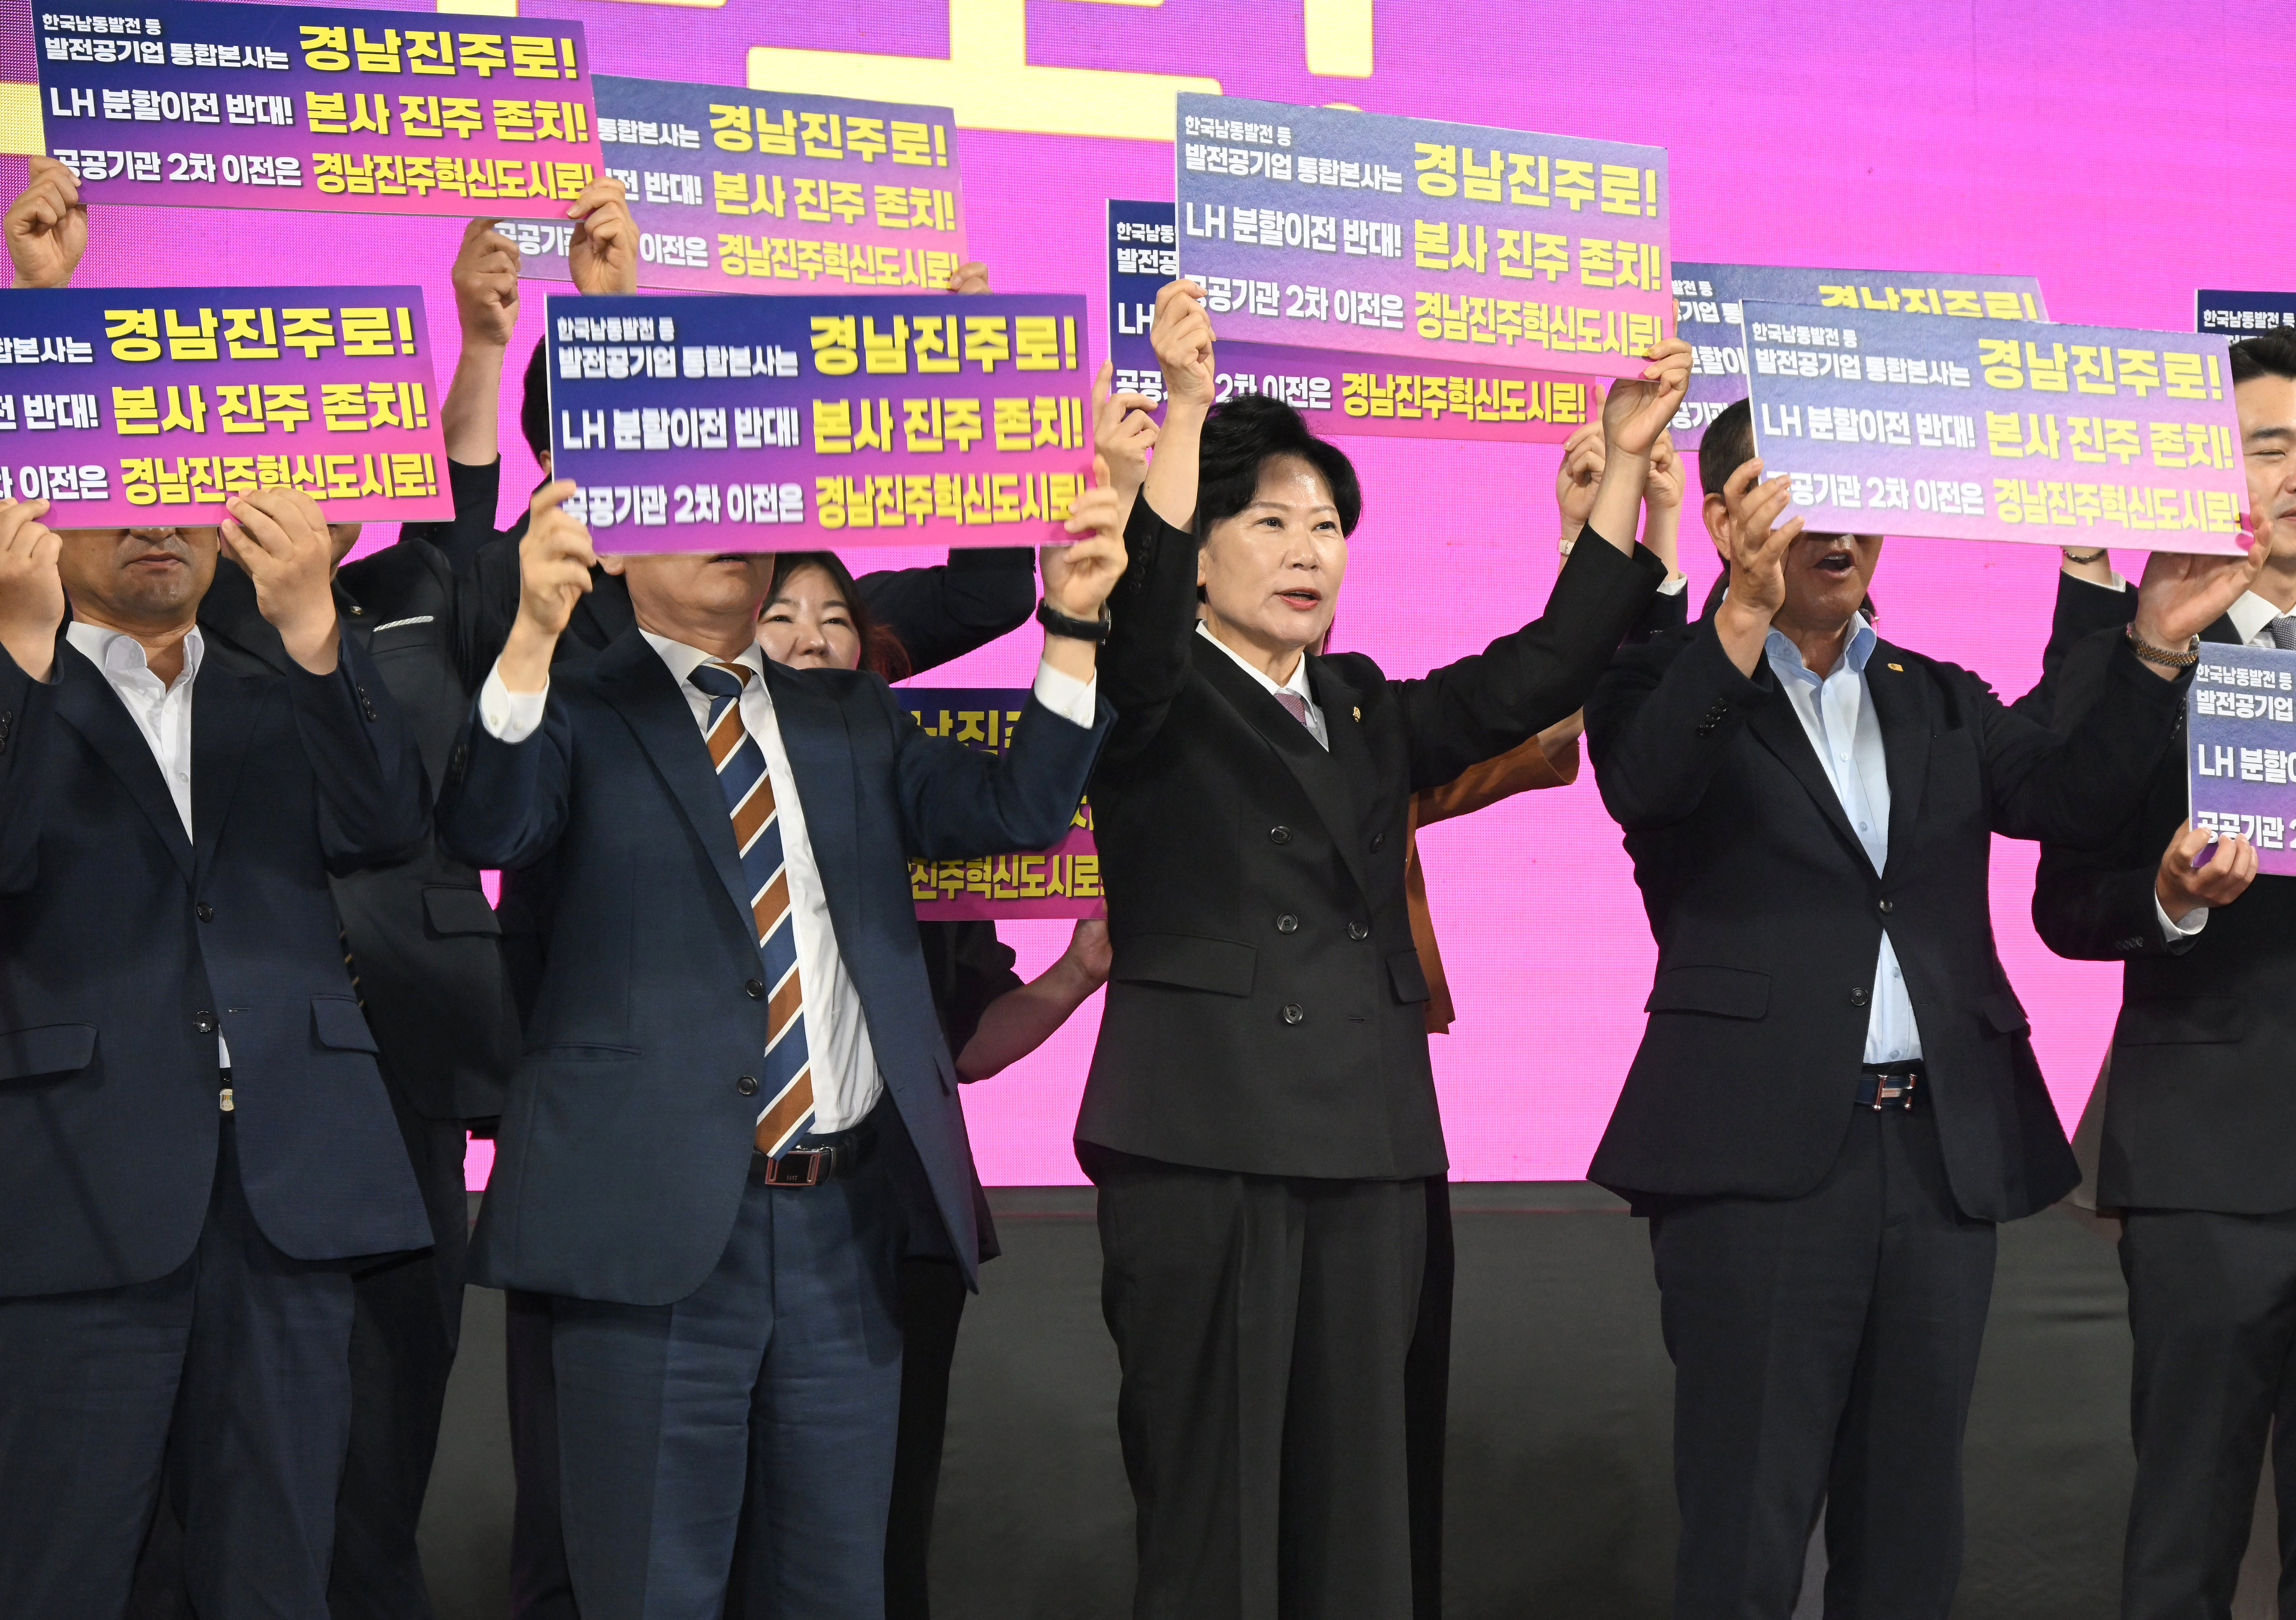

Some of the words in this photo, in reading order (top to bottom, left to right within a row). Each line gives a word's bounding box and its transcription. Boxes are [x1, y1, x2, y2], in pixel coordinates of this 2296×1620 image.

[43, 14, 140, 34] 한국남동발전
[145, 19, 160, 35] 등
[45, 38, 164, 63] 발전공기업
[171, 43, 288, 69] 통합본사는
[300, 26, 576, 78] 경남진주로!
[50, 88, 94, 116] LH
[102, 89, 219, 122] 분할이전
[226, 94, 293, 124] 반대!
[306, 91, 390, 134] 본사
[399, 96, 482, 138] 진주
[493, 100, 588, 142] 존치!
[598, 118, 699, 148] 통합본사는
[710, 104, 947, 166] 경남진주로!
[1185, 116, 1274, 144] 한국남동발전
[1277, 127, 1291, 147] 등
[54, 150, 160, 180] 공공기관
[168, 153, 216, 182] 2차
[222, 155, 301, 185] 이전은
[1186, 143, 1292, 180] 발전공기업
[1298, 157, 1402, 194] 통합본사는
[1415, 143, 1656, 216] 경남진주로!
[606, 168, 639, 200] 전
[644, 171, 702, 204] 반대!
[714, 171, 786, 217] 본사
[794, 178, 865, 224] 진주
[875, 186, 955, 230] 존치!
[640, 234, 708, 266] 이전은
[1117, 222, 1174, 242] 한국남동
[1187, 202, 1225, 239] LH
[1233, 207, 1336, 251] 분할이전
[1343, 217, 1401, 257] 반대!
[1415, 219, 1488, 273] 본사
[1497, 229, 1569, 281] 진주
[1580, 239, 1660, 290] 존치!
[1286, 284, 1328, 321] 2차
[1334, 289, 1403, 329] 이전은
[1699, 281, 1713, 296] 등
[105, 307, 414, 361] 경남진주로!
[558, 318, 654, 340] 한국남동발전
[659, 318, 674, 340] 등
[1119, 303, 1150, 334] LH
[1752, 322, 1839, 347] 한국남동발전
[1843, 329, 1857, 348] 등
[2204, 310, 2279, 328] 한국남동발전
[559, 347, 676, 378] 발전공기업
[683, 346, 798, 377] 통합본사는
[811, 316, 1076, 375] 경남진주로!
[1756, 348, 1861, 380] 발전공기업
[1863, 356, 1972, 389] 통합본사는
[1979, 339, 2222, 399] 경남진주로!
[23, 394, 98, 429] 반대!
[113, 386, 206, 434] 본사
[217, 385, 309, 432] 진주
[322, 382, 427, 430] 존치!
[1116, 370, 1168, 404] 공공
[1263, 375, 1331, 408] 이전은
[1342, 373, 1585, 422] 경남진주혁신도시로!
[562, 411, 605, 448] LH
[614, 409, 727, 448] 분할이전
[735, 408, 798, 447] 반대!
[814, 399, 893, 453] 본사
[904, 399, 982, 452] 진주
[994, 397, 1083, 450] 존치!
[1762, 403, 1803, 440] LH
[1806, 404, 1913, 448] 분할이전
[1915, 410, 1976, 450] 반대!
[1987, 411, 2060, 458] 본사
[2068, 417, 2141, 463] 진주
[2151, 422, 2233, 468] 존치!
[20, 465, 108, 499] 이전은
[121, 453, 436, 507] 경남진주혁신도시로!
[1866, 475, 1909, 512] 2차
[1915, 478, 1986, 516] 이전은
[674, 485, 721, 522] 2차
[727, 485, 803, 521] 이전은
[2197, 663, 2275, 688] 한국남동발전
[2279, 672, 2292, 690] 등
[2197, 689, 2293, 722] 발전공기업
[2198, 744, 2233, 777] LH
[908, 855, 1105, 899] 진주혁신도시로
